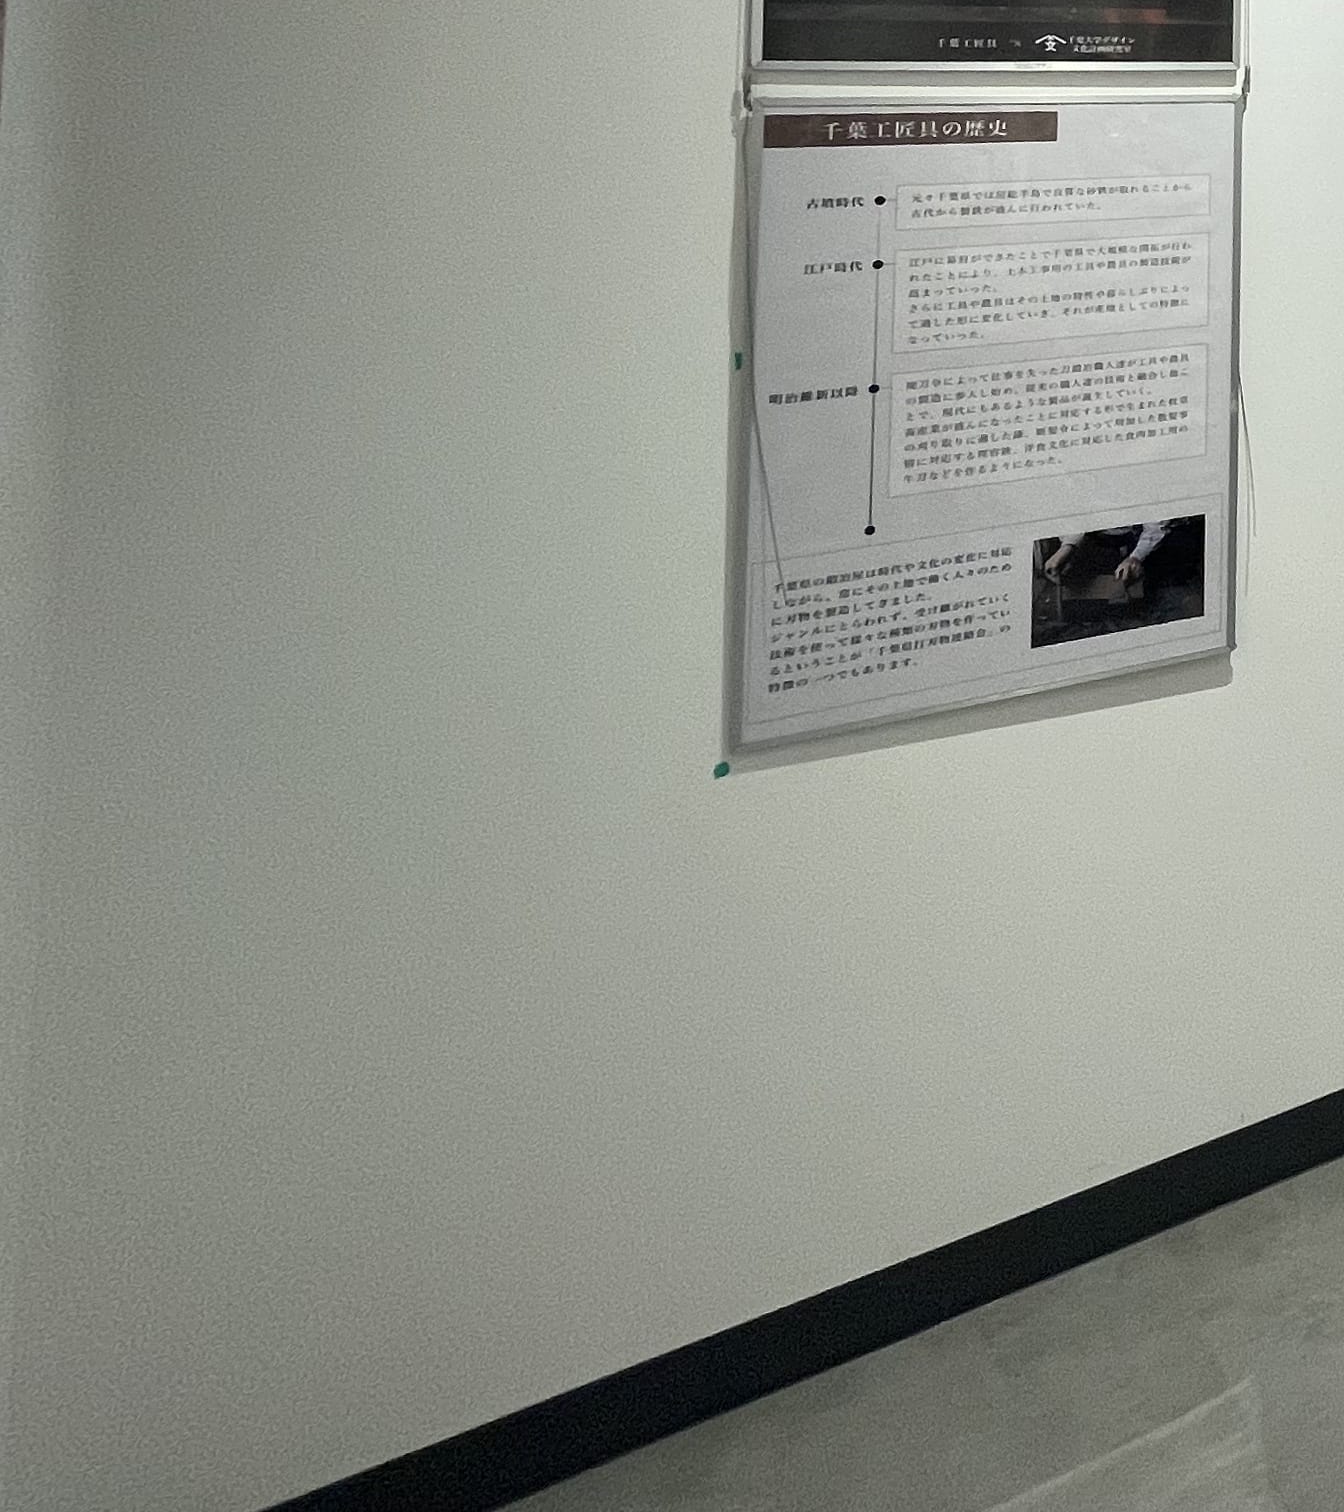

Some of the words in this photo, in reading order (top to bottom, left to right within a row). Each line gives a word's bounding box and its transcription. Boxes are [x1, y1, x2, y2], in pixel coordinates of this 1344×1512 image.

[823, 119, 1009, 140] 千葉工匠具の歴史
[803, 261, 862, 275] 江戸時代
